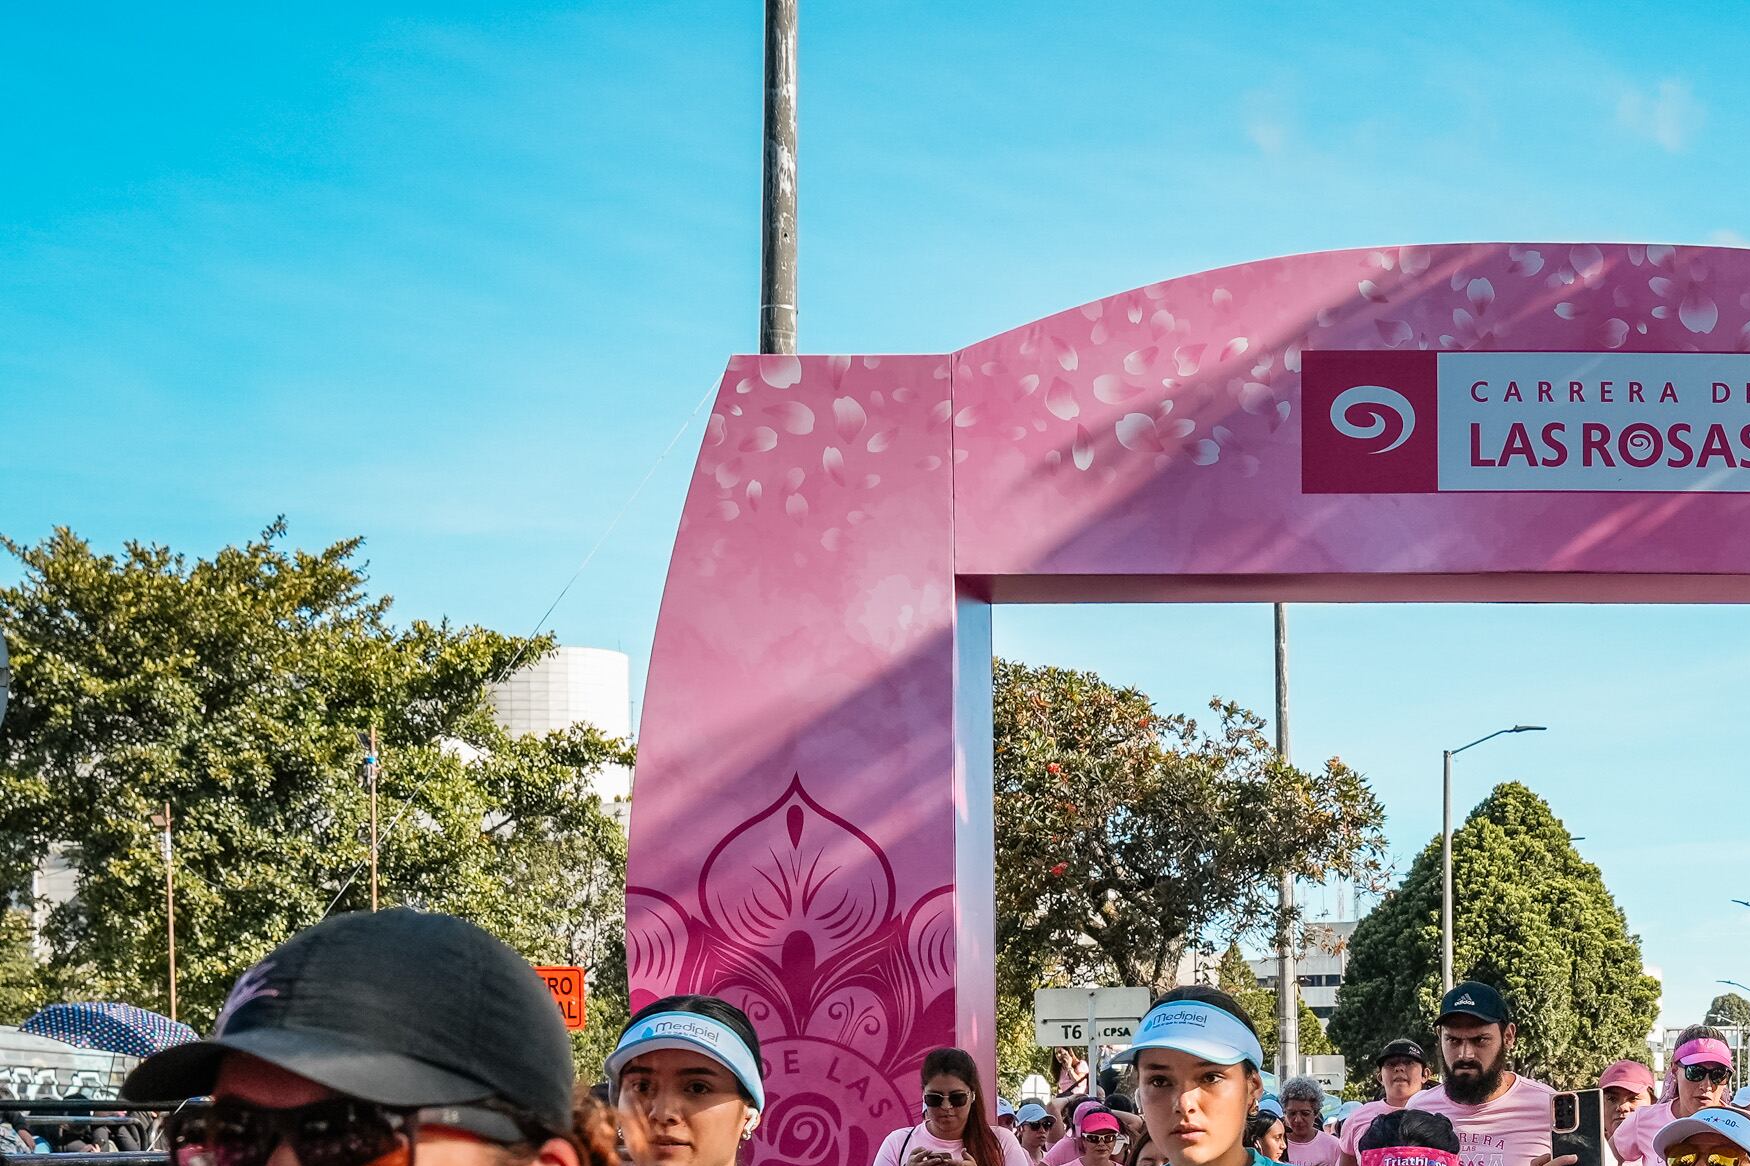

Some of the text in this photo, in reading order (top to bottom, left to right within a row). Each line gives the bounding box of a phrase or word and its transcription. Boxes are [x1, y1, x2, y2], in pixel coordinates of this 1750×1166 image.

[1469, 380, 1680, 405] CARRERA
[1470, 421, 1568, 469] LAS
[1061, 1025, 1082, 1040] T6
[1103, 1027, 1131, 1037] CPSA
[826, 1056, 893, 1118] LAS
[1459, 1132, 1505, 1150] RERA
